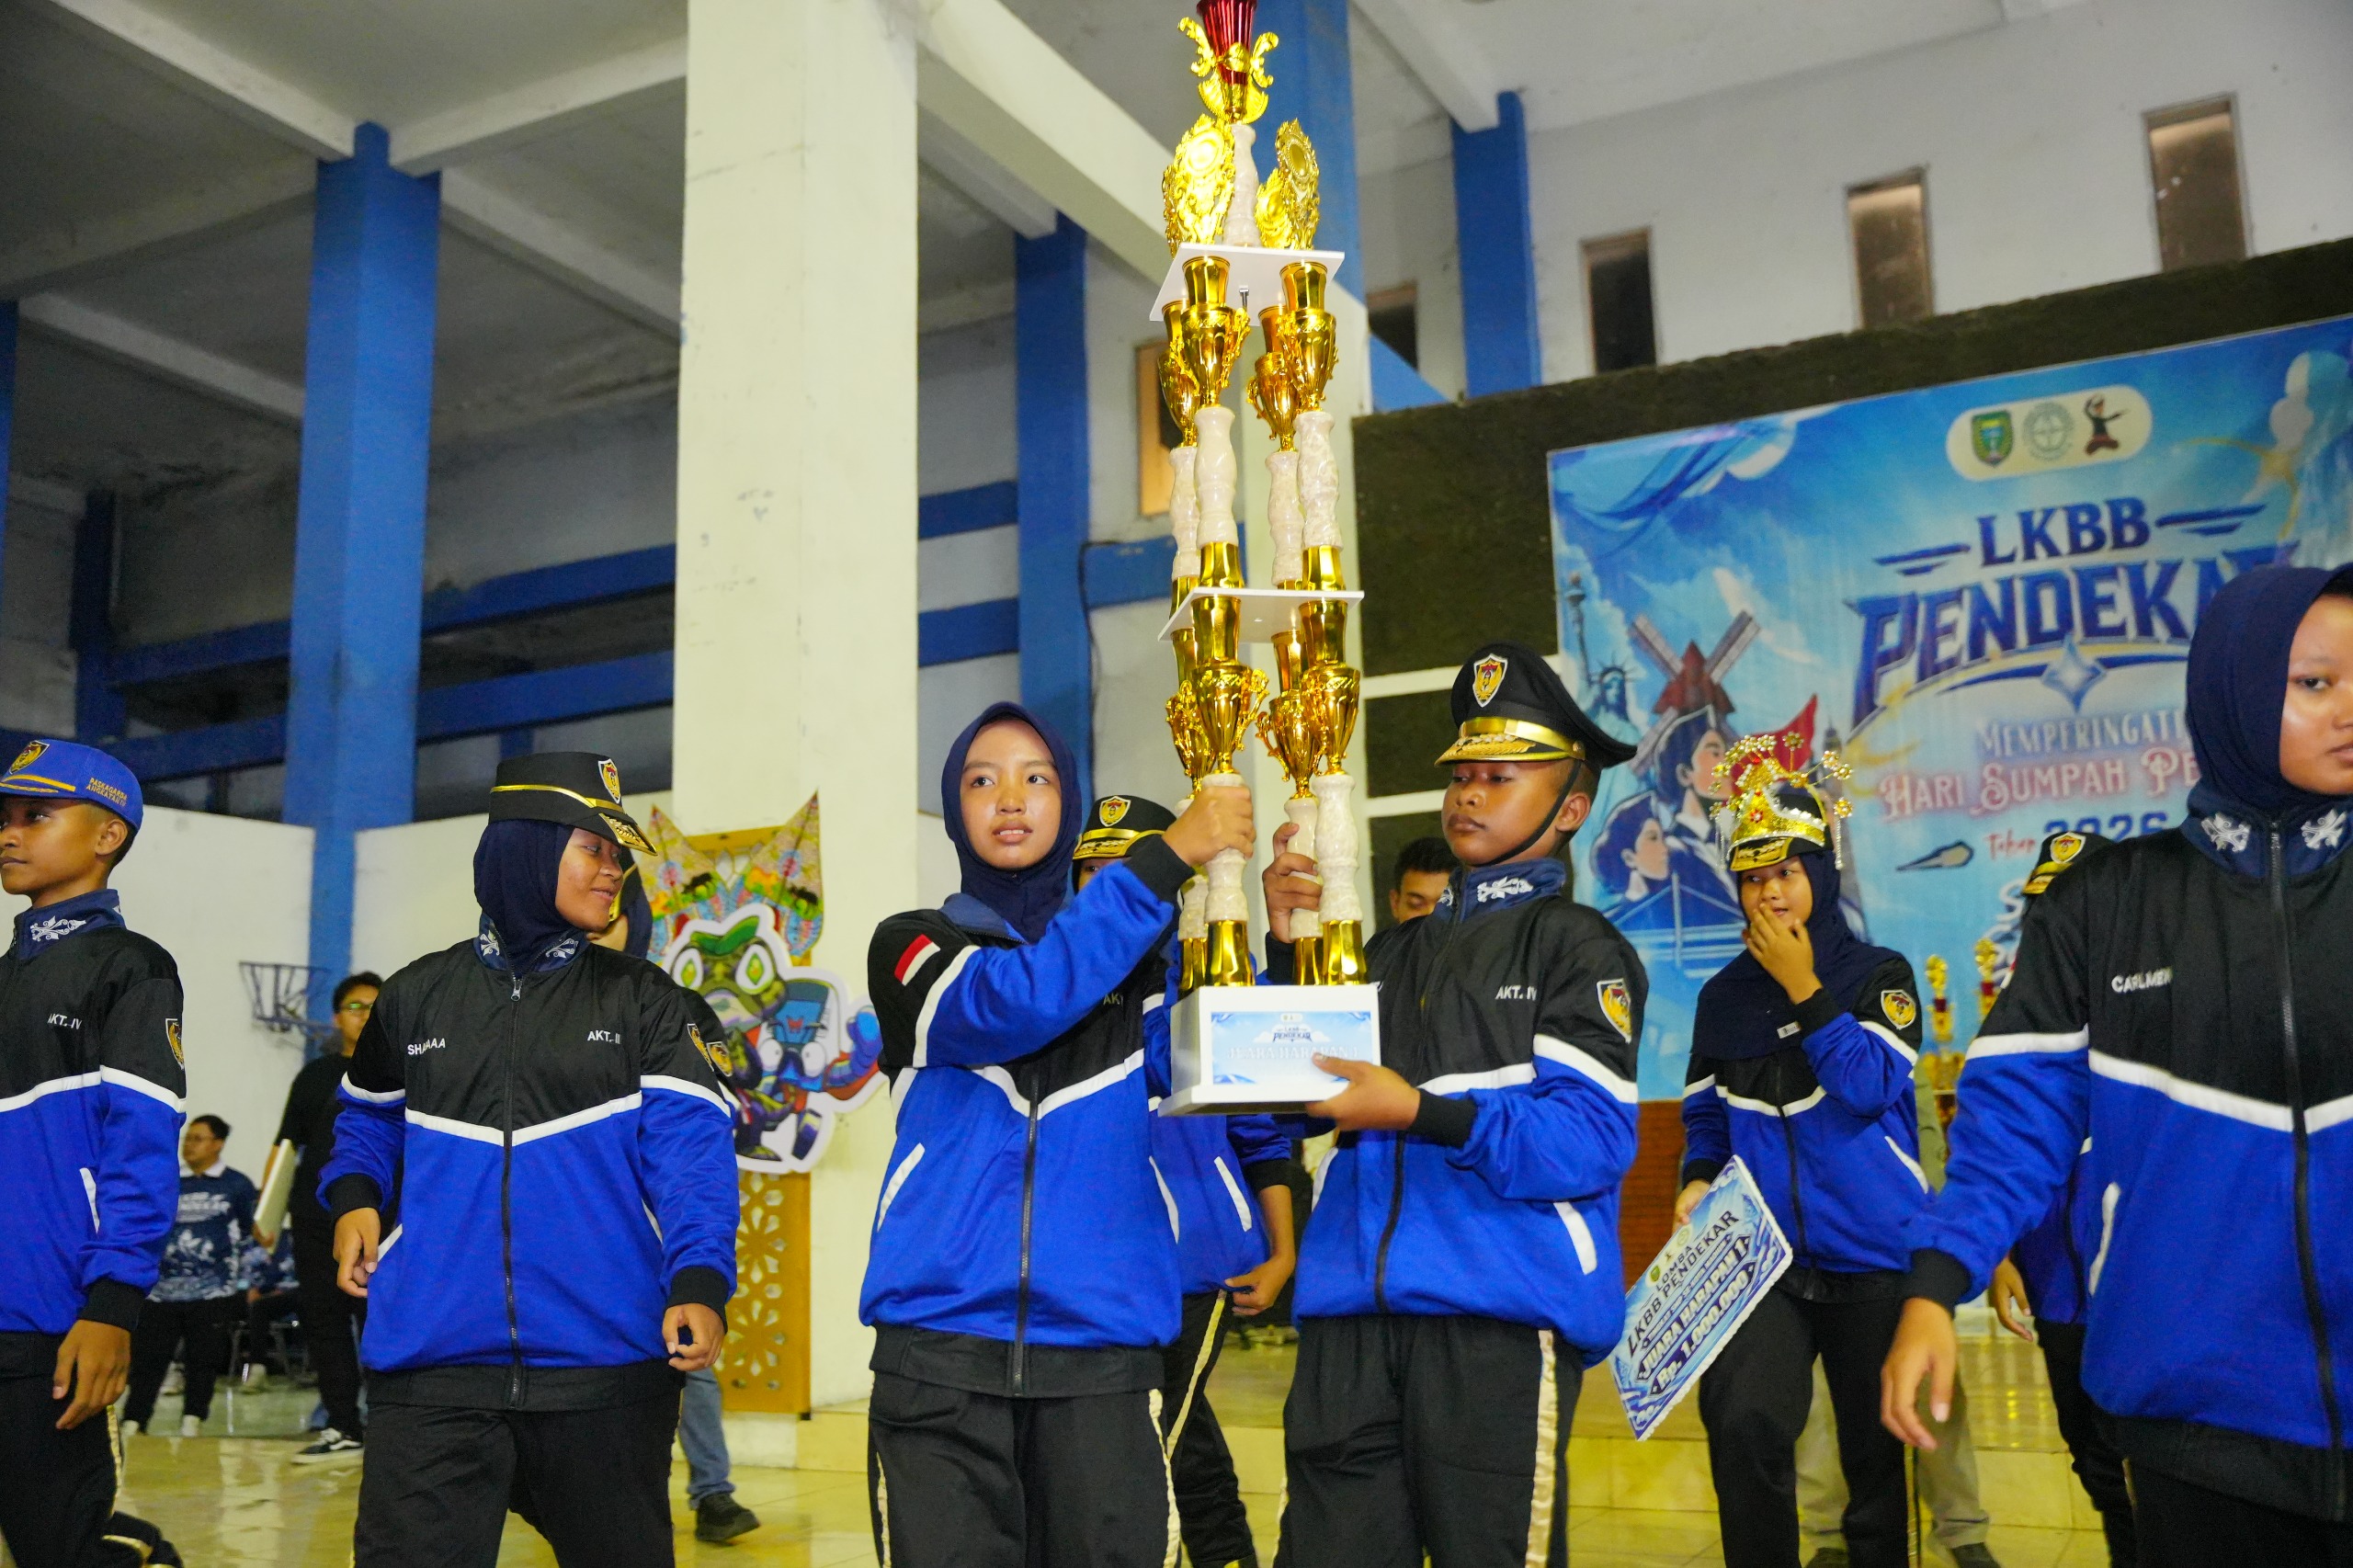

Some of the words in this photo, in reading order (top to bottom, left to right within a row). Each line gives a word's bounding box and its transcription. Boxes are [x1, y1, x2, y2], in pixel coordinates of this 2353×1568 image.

[1976, 497, 2153, 568] LKBB
[1879, 774, 1964, 822] HARI
[1970, 761, 2127, 816] SUMPAH
[2141, 746, 2201, 798] PE
[70, 1017, 83, 1030] IV
[1495, 984, 1524, 1000] AKT.
[1628, 1297, 1662, 1358] LKBB
[1663, 1210, 1740, 1298] PENDEKAR
[1655, 1244, 1694, 1291] LOMBA
[1641, 1321, 1683, 1378] JUARA
[1679, 1248, 1740, 1329] HARAPAN
[1655, 1359, 1683, 1387] Rp.
[1680, 1269, 1749, 1358] 1.000.000
